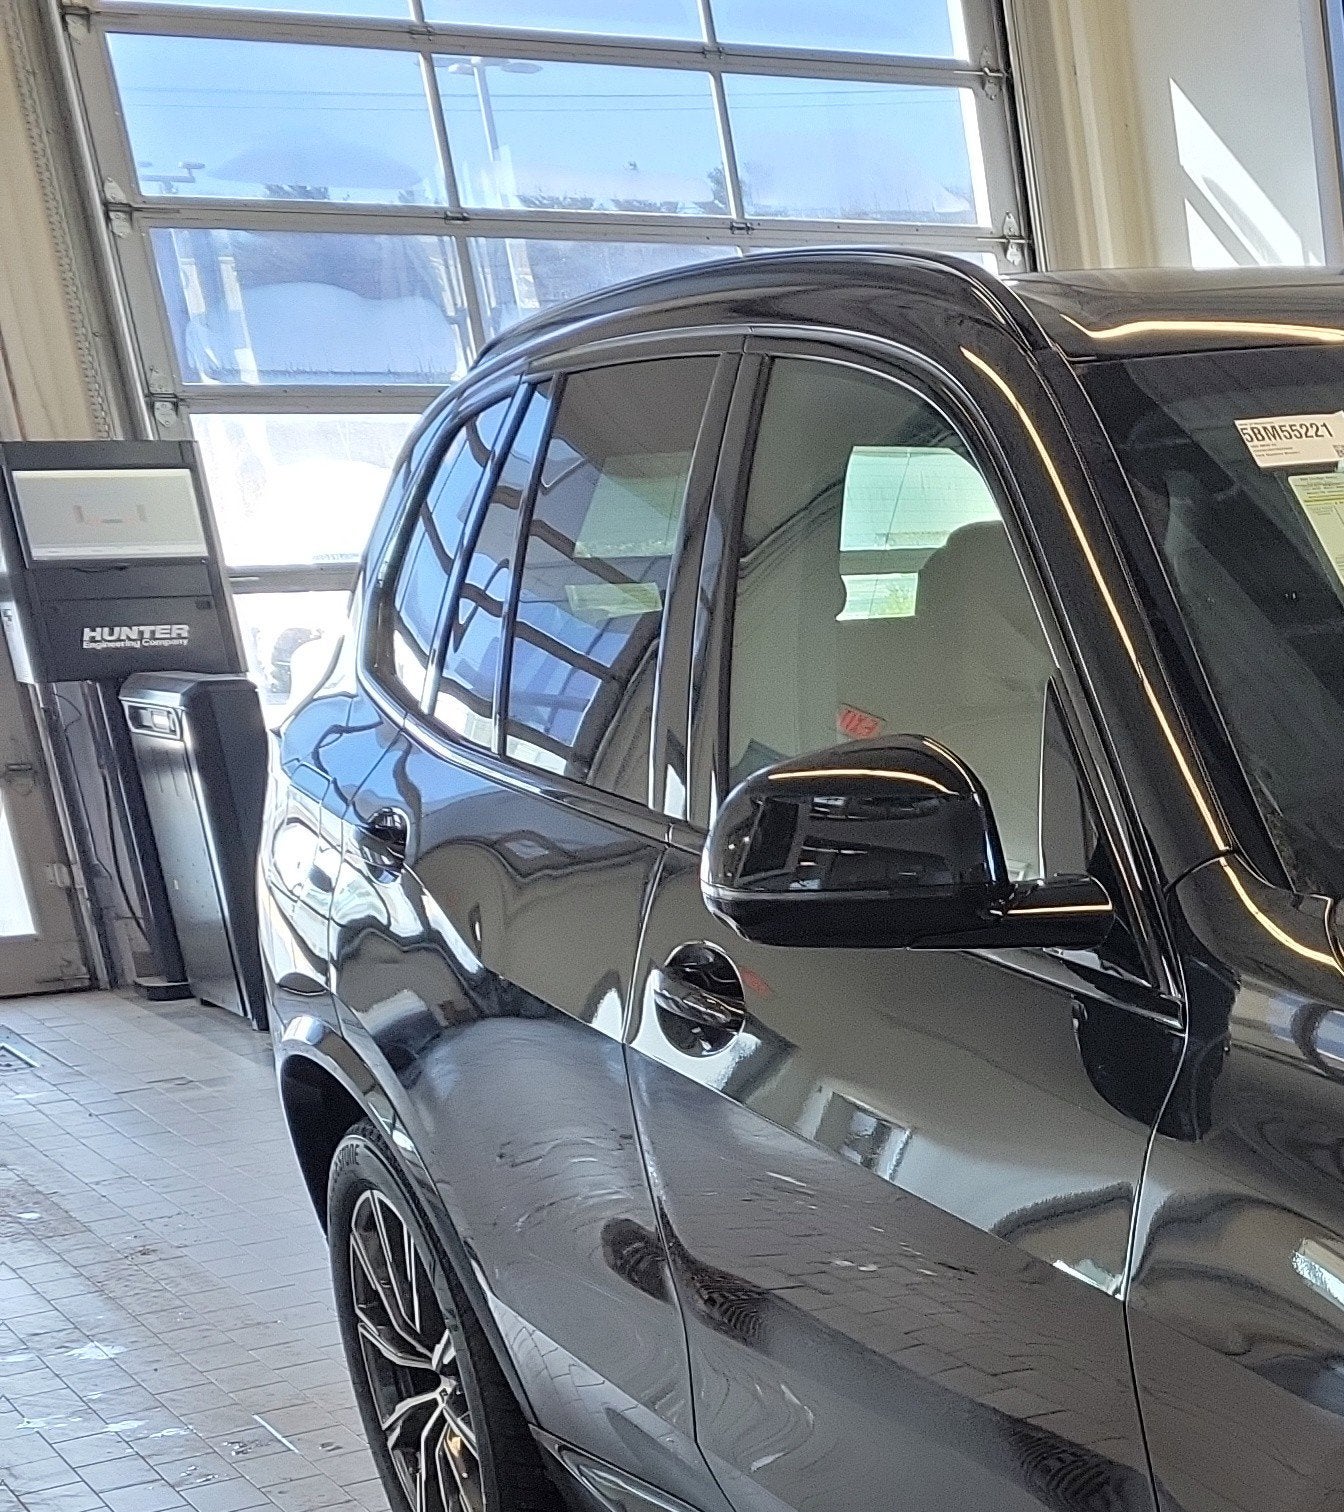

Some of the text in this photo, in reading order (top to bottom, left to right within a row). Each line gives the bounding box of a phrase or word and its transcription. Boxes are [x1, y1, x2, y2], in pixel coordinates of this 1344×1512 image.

[1240, 421, 1334, 443] 5BM55221
[83, 625, 189, 640] HUNTER
[83, 638, 188, 649] Engineering Company
